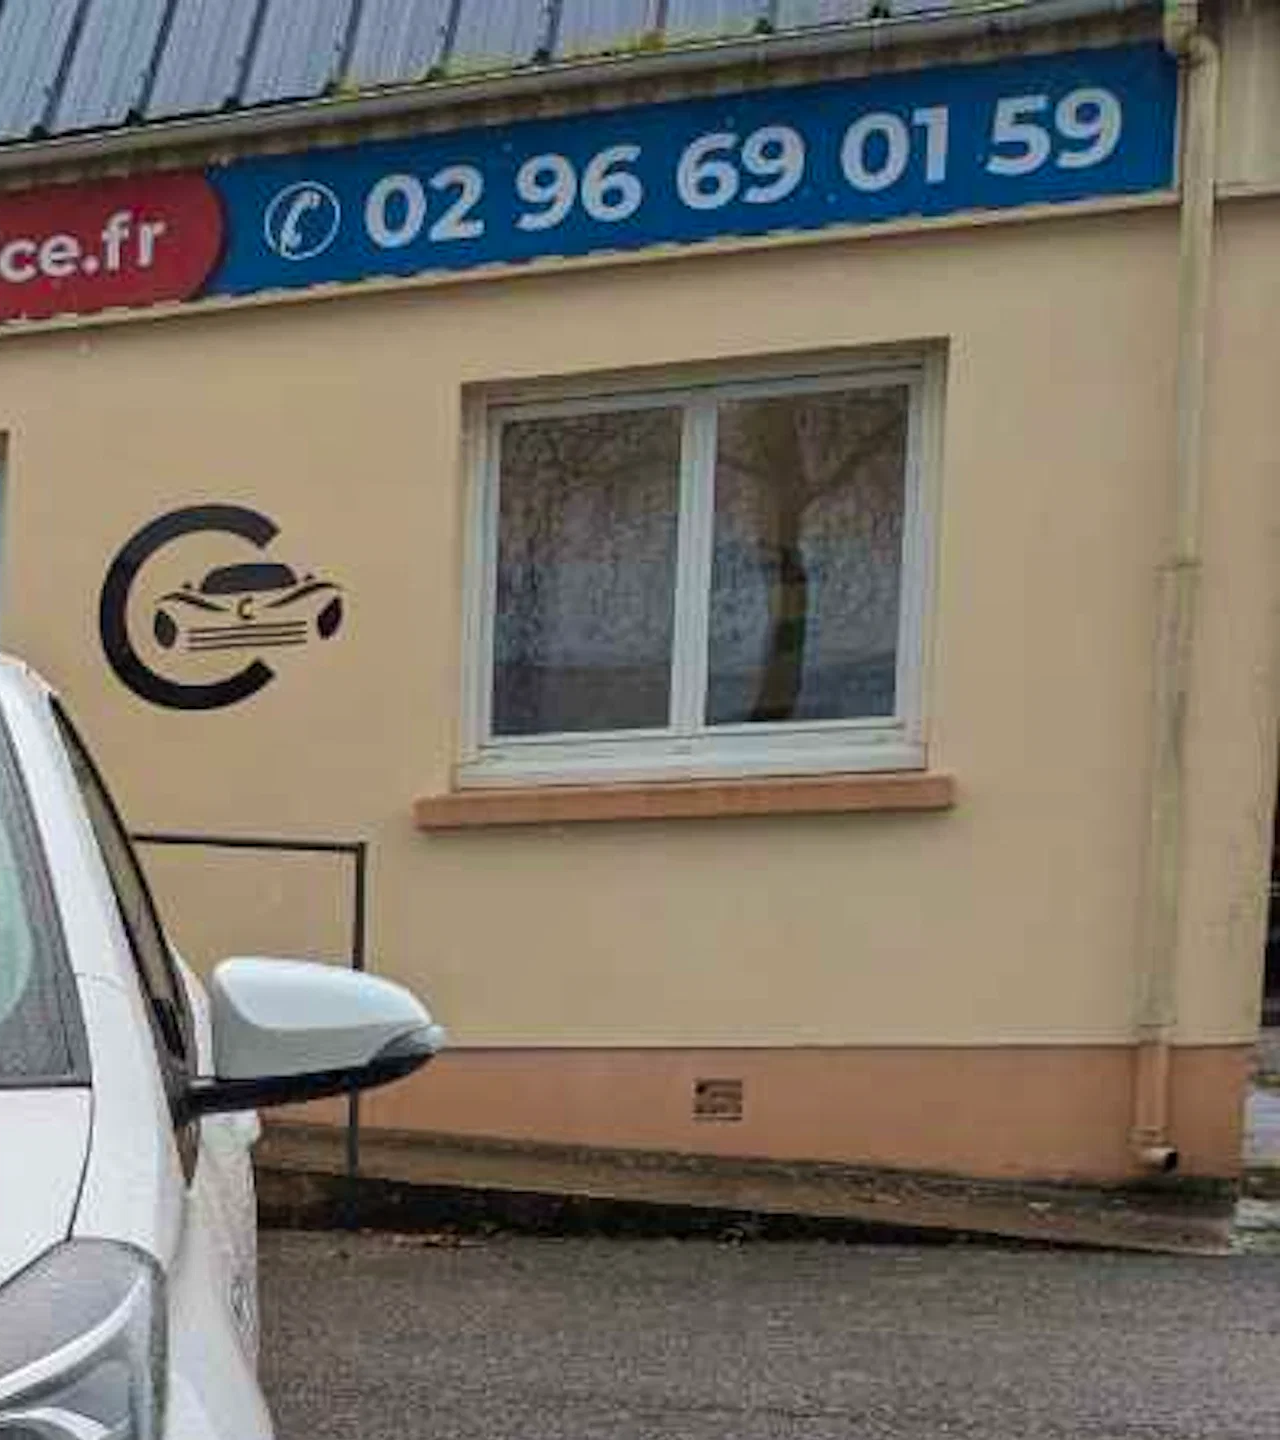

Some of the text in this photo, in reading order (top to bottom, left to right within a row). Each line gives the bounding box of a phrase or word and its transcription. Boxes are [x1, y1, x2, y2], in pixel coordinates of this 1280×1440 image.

[364, 87, 1122, 249] 02 96 69 01 59
